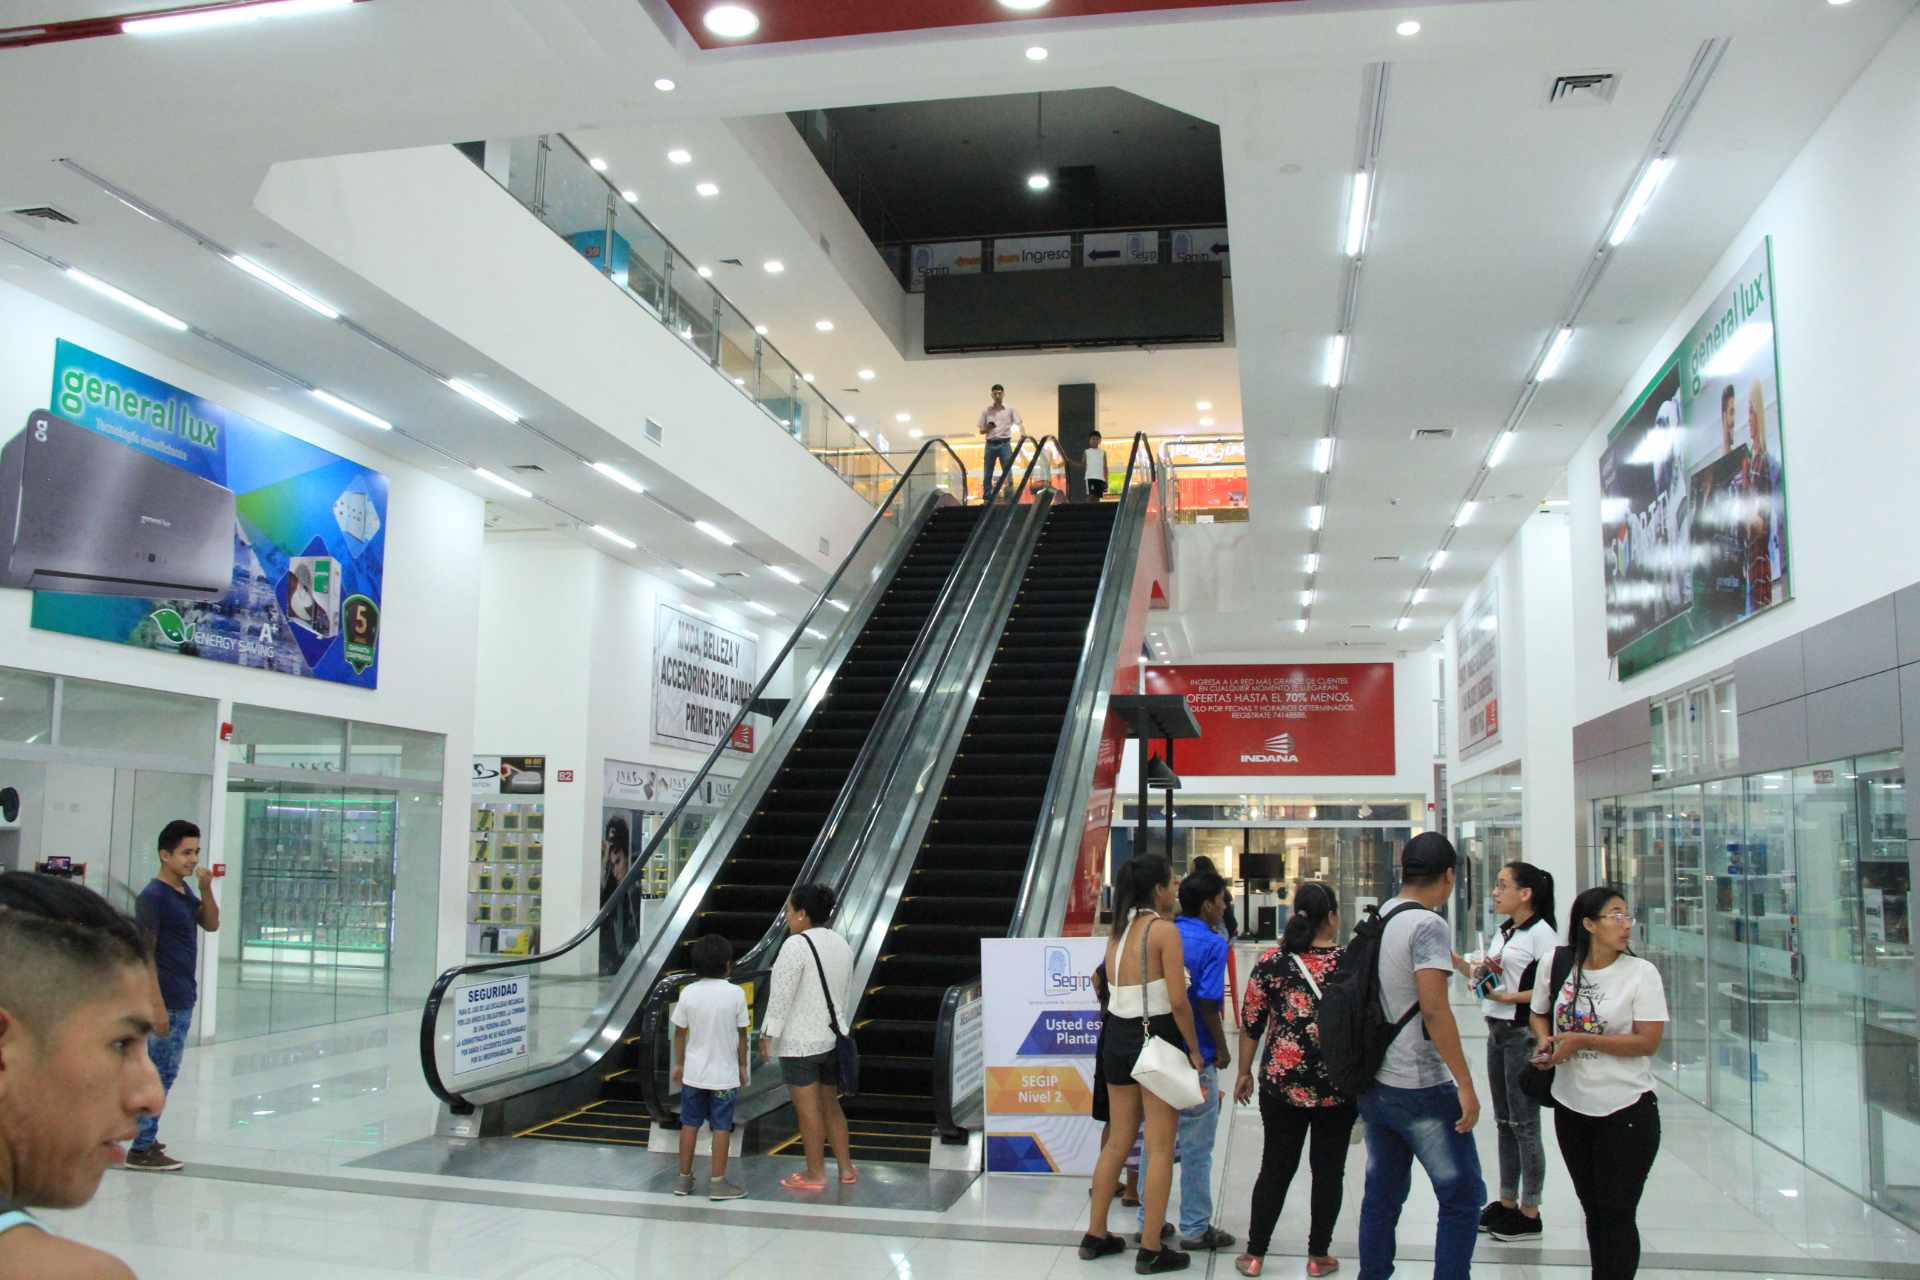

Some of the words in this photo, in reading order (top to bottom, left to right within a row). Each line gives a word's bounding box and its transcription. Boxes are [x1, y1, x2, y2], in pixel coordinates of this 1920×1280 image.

[1022, 249, 1071, 264] Ingreso
[1692, 291, 1738, 396] general
[1740, 272, 1765, 322] lux
[61, 371, 175, 432] general
[180, 405, 217, 448] lux
[354, 605, 368, 634] 5
[195, 631, 235, 651] ENERGY
[238, 640, 275, 658] SAVING
[703, 631, 733, 667] BELLEZA
[734, 641, 741, 669] Y
[660, 655, 710, 697] ACCESORIOS
[711, 671, 729, 701] PARA
[1186, 693, 1232, 704] OFERTAS
[1234, 693, 1269, 703] HASTA
[1271, 693, 1281, 703] EL
[1285, 692, 1307, 703] 70%
[1310, 692, 1353, 703] MENOS.
[685, 702, 713, 737] PRIMER
[1240, 754, 1299, 763] INDANA
[1052, 972, 1091, 991] Segip
[468, 983, 518, 1003] SEGURIDAD
[1046, 1018, 1083, 1031] Usted
[1056, 1032, 1097, 1044] Planta
[1022, 1074, 1058, 1088] SEGIP
[1018, 1091, 1050, 1104] Nivel
[1055, 1091, 1063, 1103] 2
